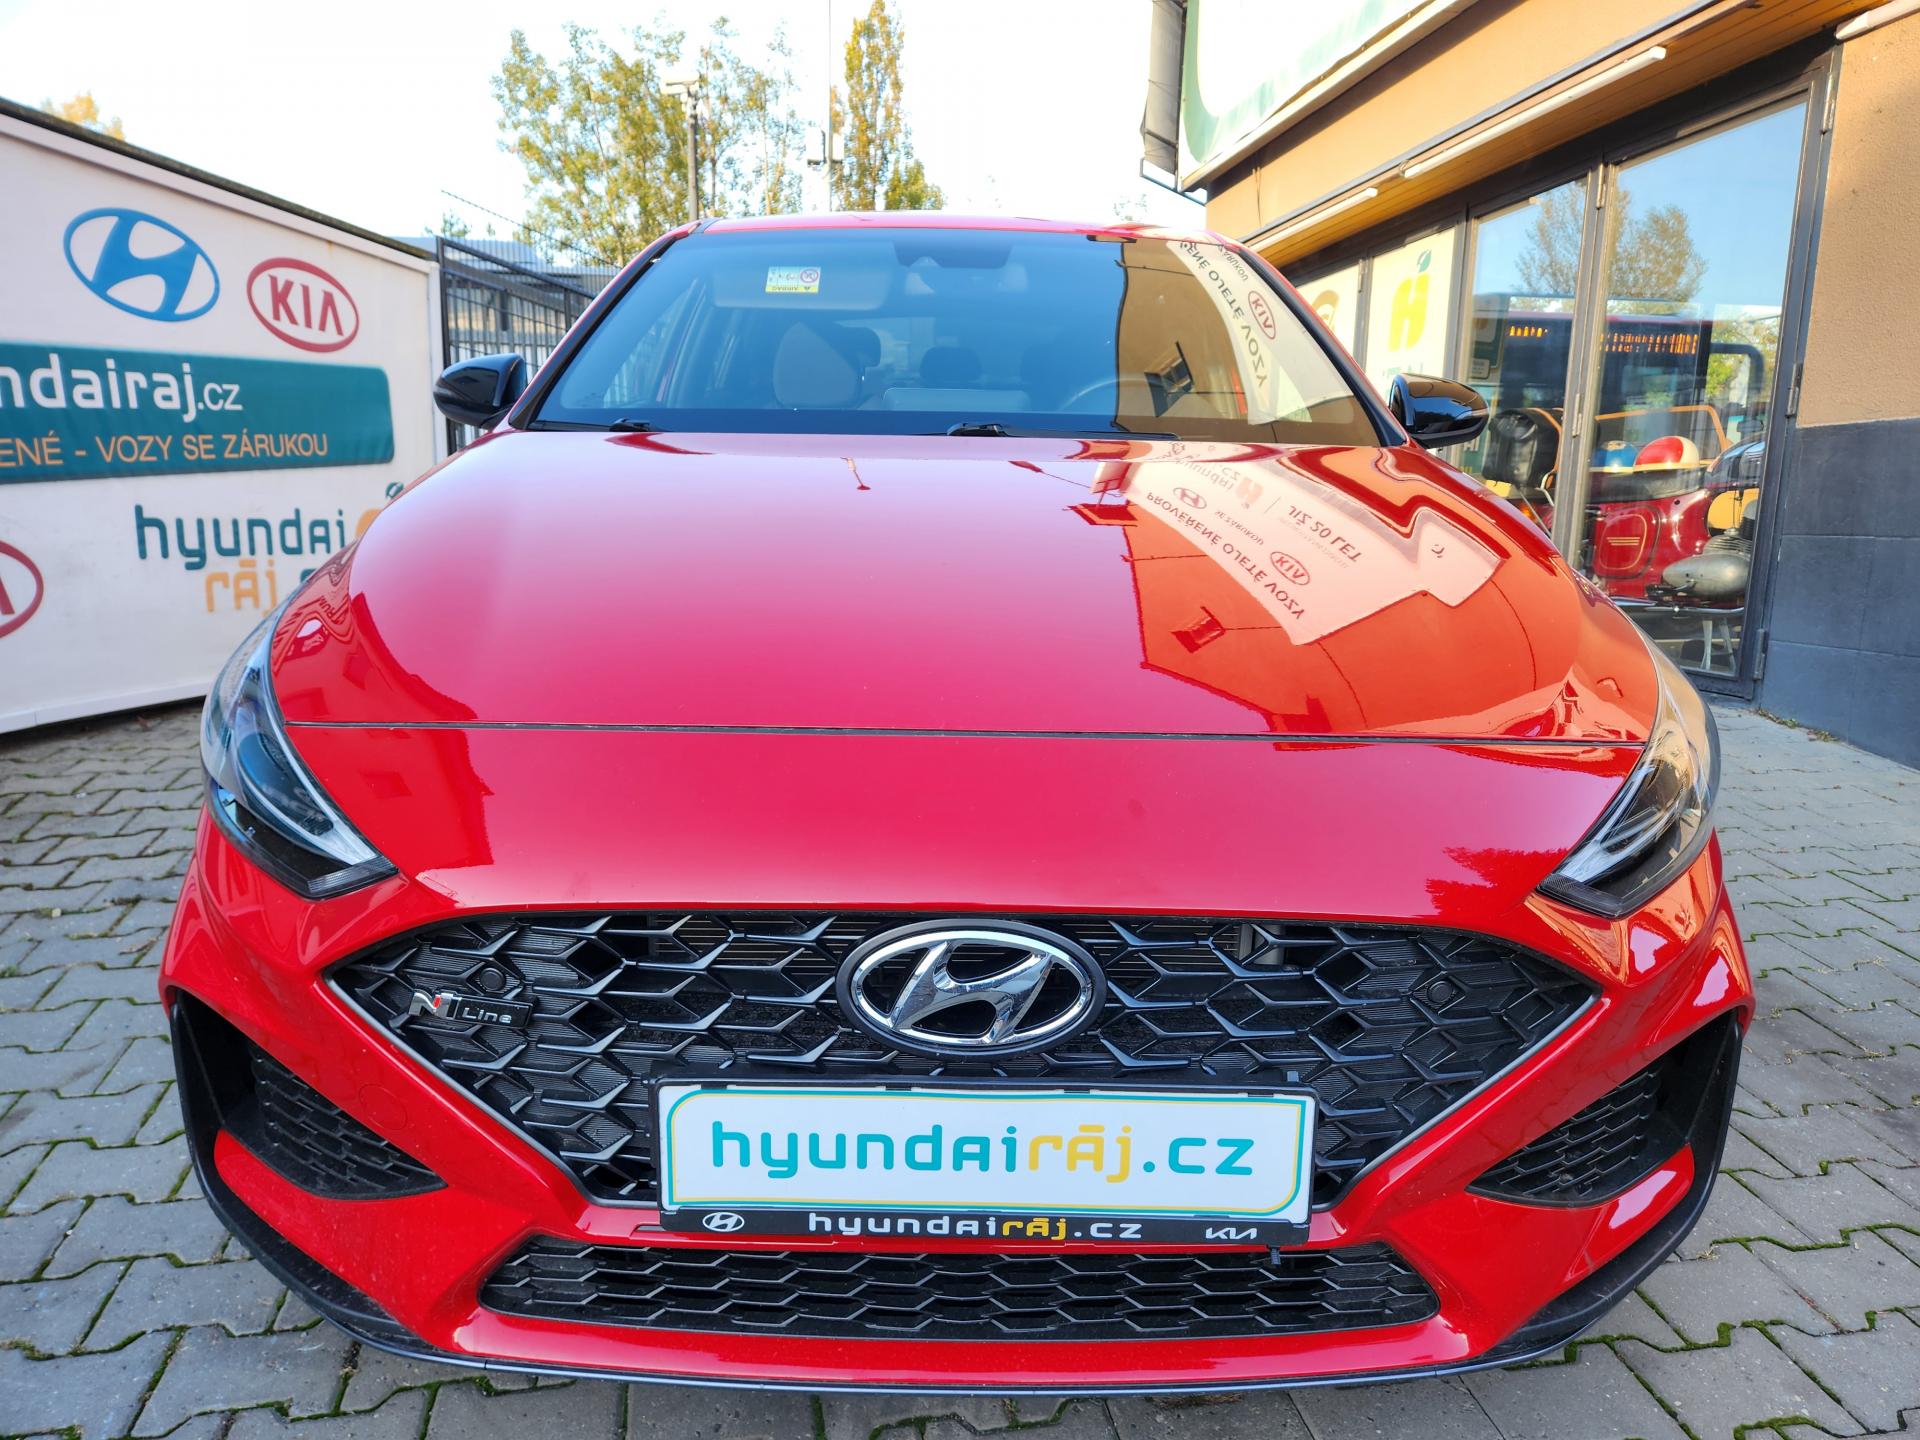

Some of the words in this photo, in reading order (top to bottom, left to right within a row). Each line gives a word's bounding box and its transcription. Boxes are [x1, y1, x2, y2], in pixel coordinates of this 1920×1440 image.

[269, 274, 345, 336] KIA
[95, 435, 173, 463] VOZY
[182, 434, 217, 460] SE
[222, 429, 329, 459] ZÁRUKOU
[134, 504, 347, 571] hyundai
[462, 1007, 512, 1024] Line
